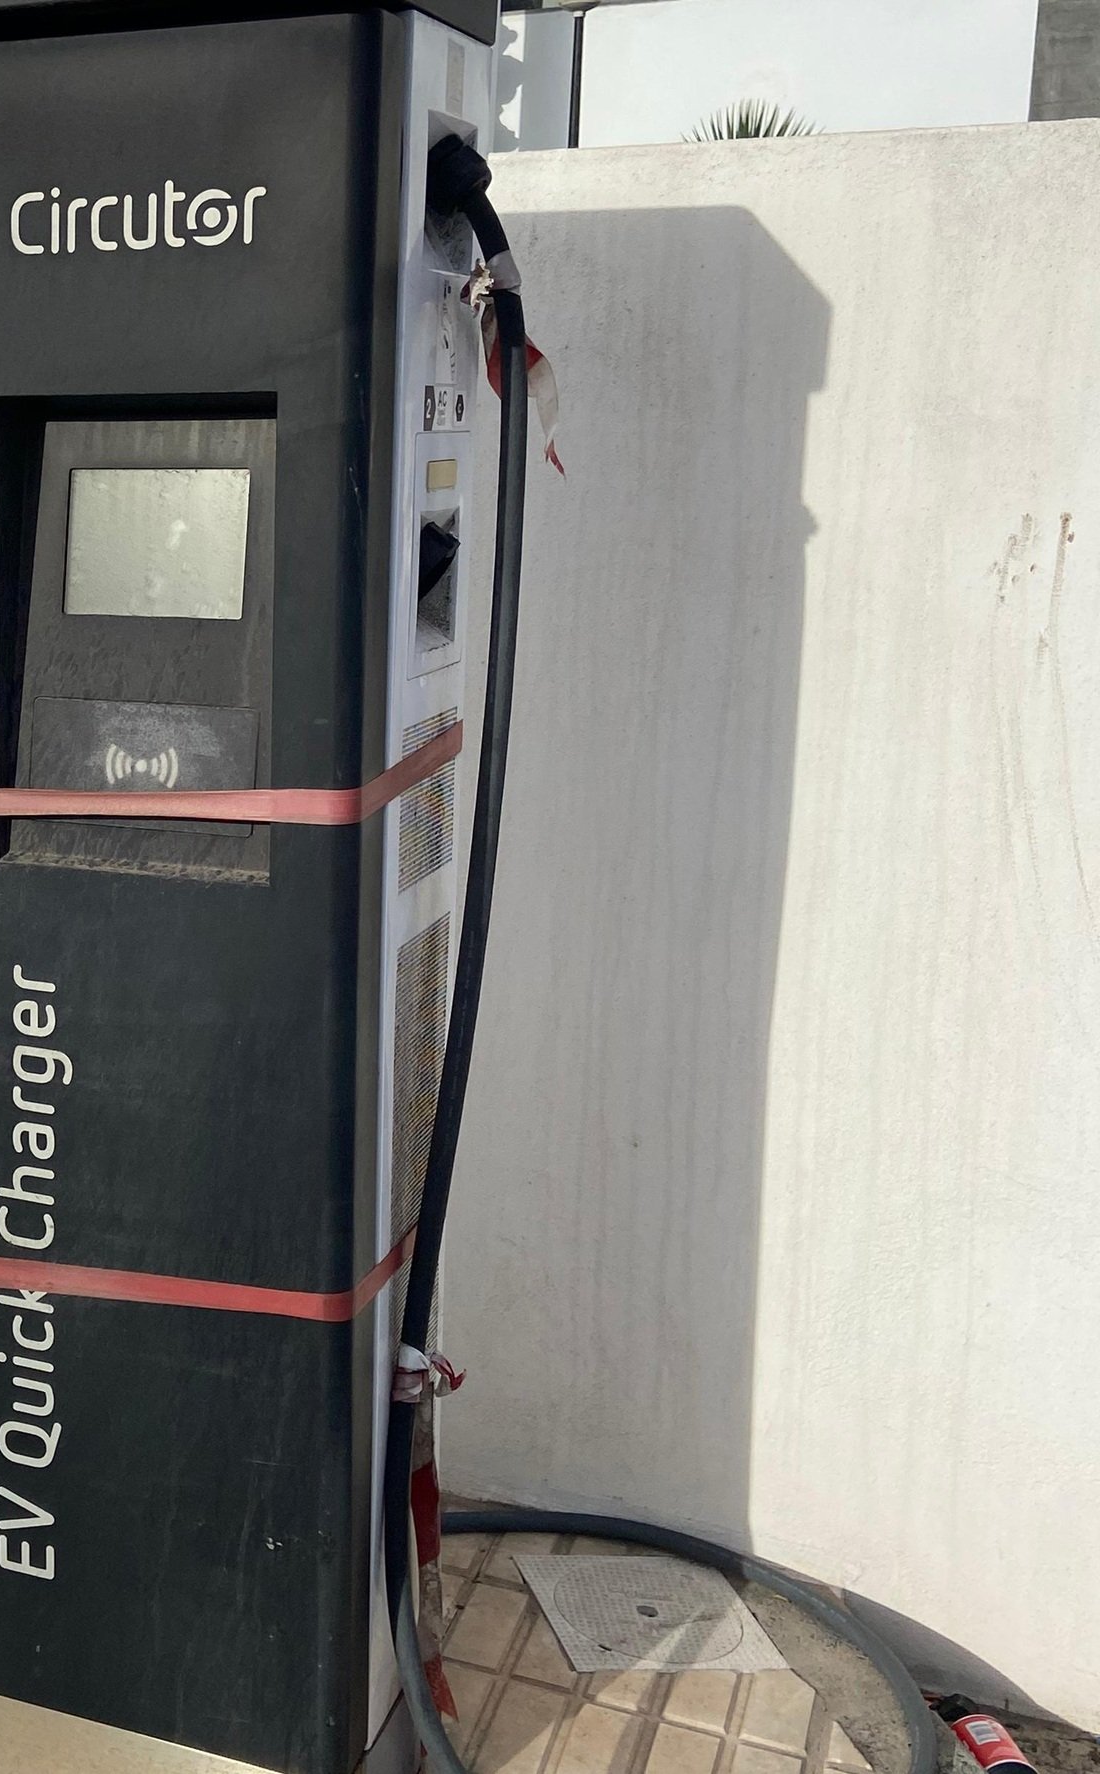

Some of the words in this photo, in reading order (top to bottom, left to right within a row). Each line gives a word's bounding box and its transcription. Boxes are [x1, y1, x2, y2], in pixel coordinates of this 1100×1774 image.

[10, 179, 268, 255] Circutor
[426, 398, 432, 419] 2
[438, 391, 447, 407] AC
